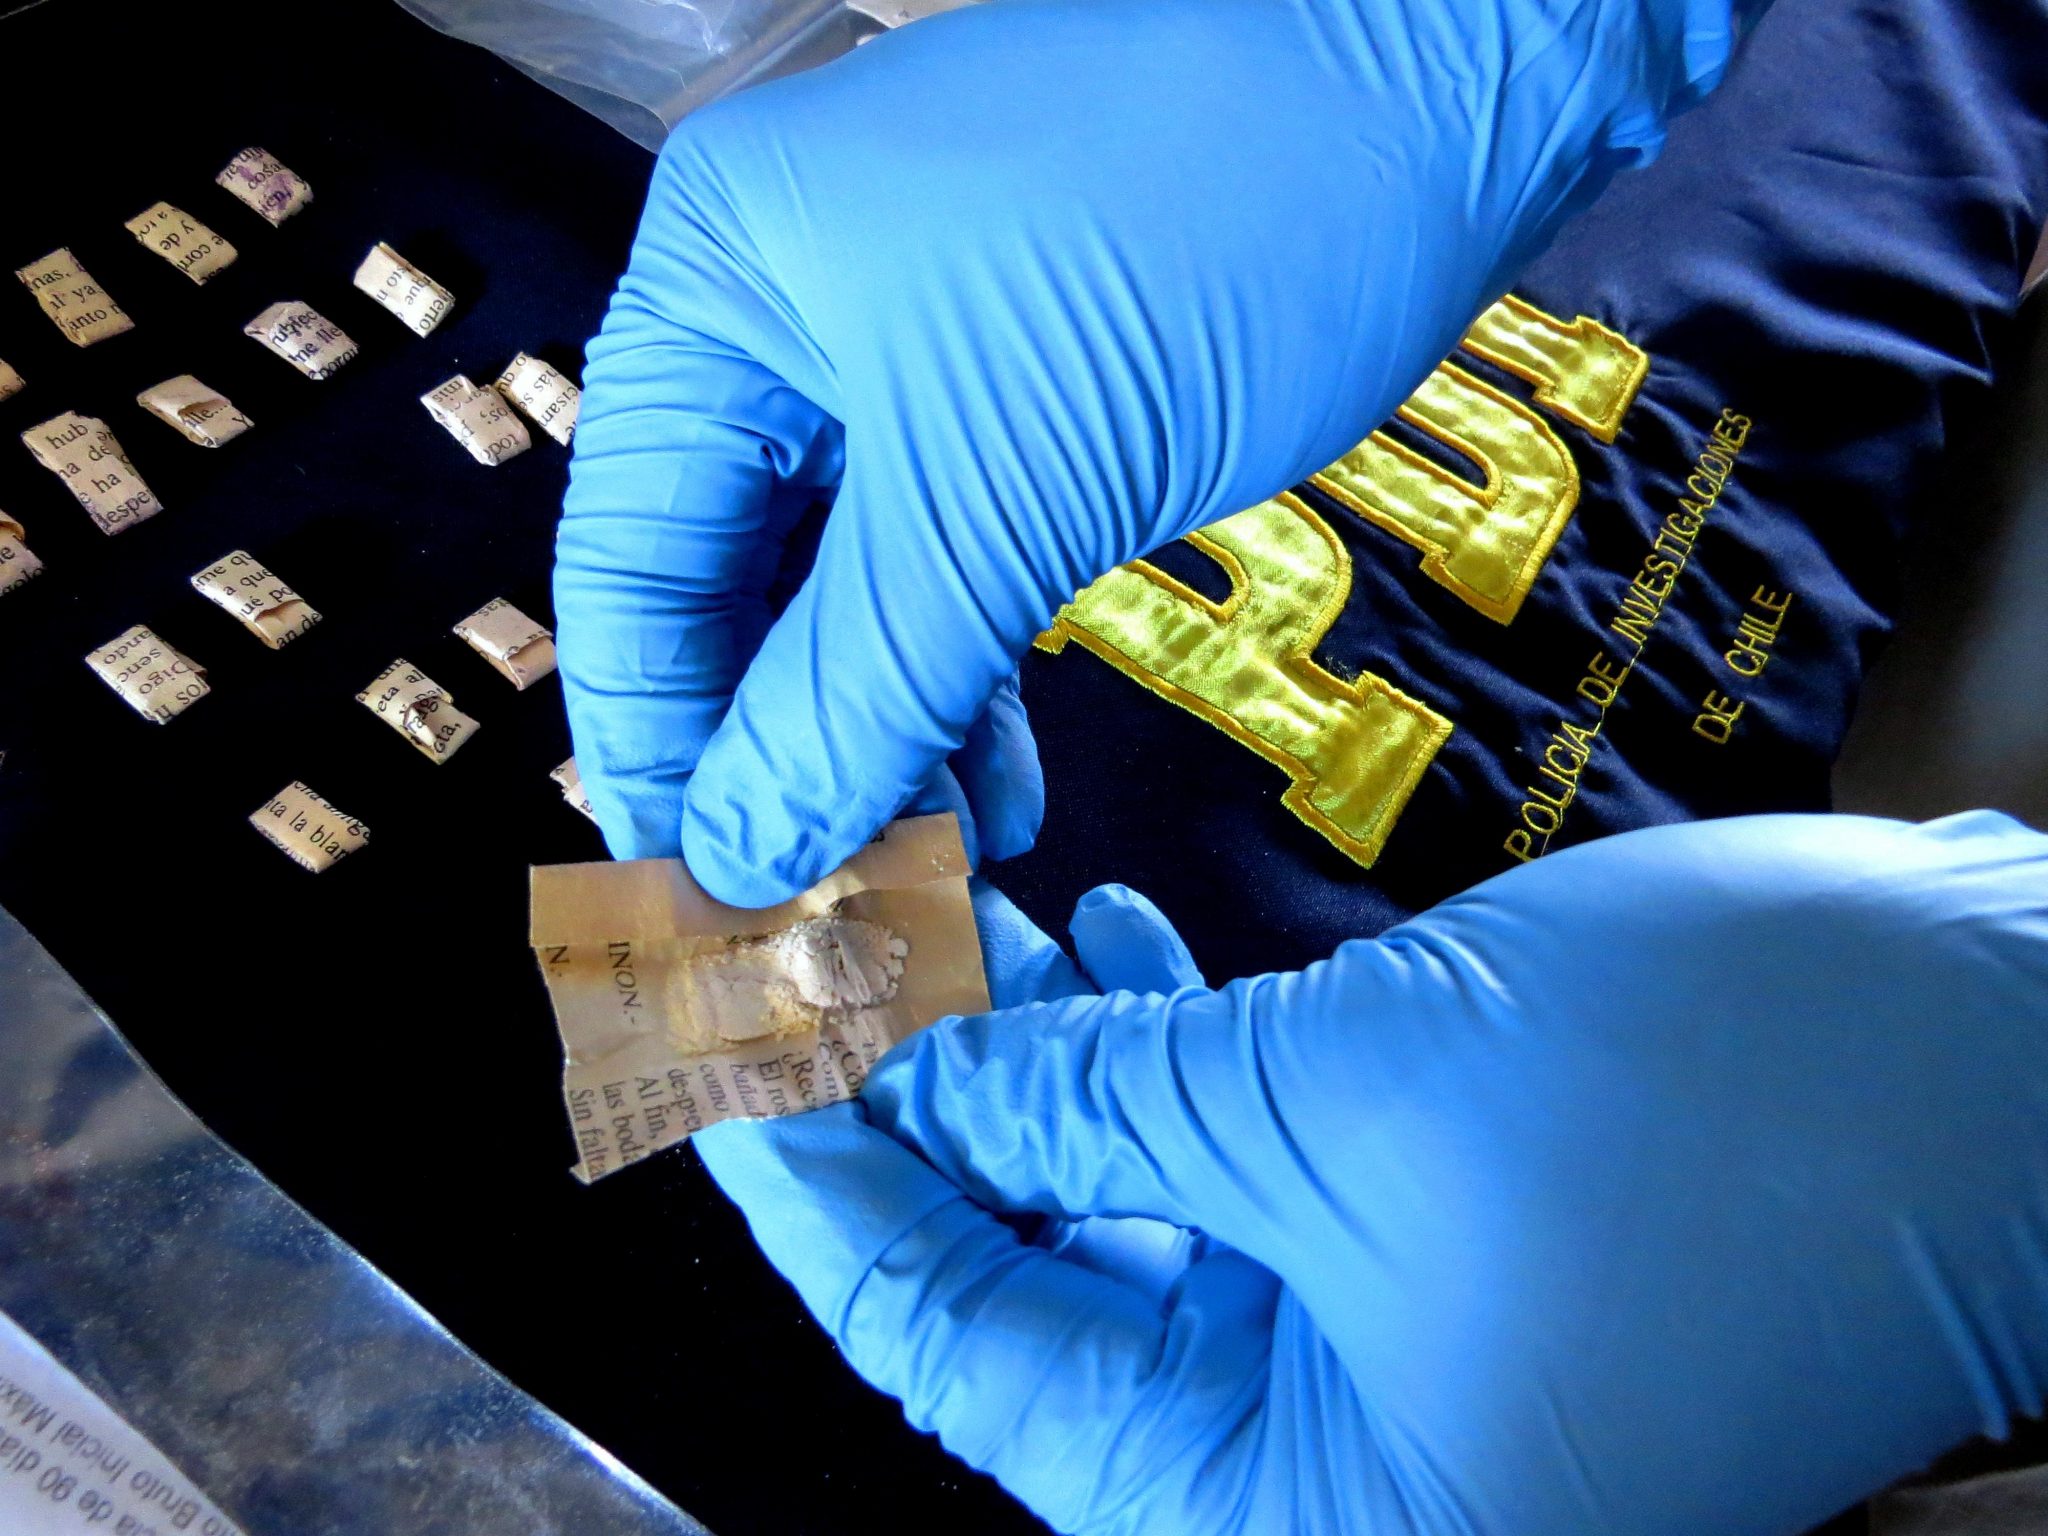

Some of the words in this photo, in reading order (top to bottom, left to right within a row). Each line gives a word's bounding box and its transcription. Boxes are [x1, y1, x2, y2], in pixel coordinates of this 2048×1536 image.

[160, 233, 180, 252] de
[47, 419, 87, 449] hub
[92, 469, 120, 493] ha
[1503, 720, 1598, 863] POLICIA
[1576, 652, 1630, 708] DE
[1610, 407, 1752, 644] INVESTIGACIONES
[1691, 689, 1745, 745] DE
[1723, 584, 1793, 678] CHILE
[290, 810, 309, 830] la
[635, 1076, 660, 1100] Al
[570, 1088, 595, 1122] Sin
[52, 1420, 130, 1485] Inicial
[78, 1489, 113, 1522] de
[130, 1470, 200, 1530] Bruto
